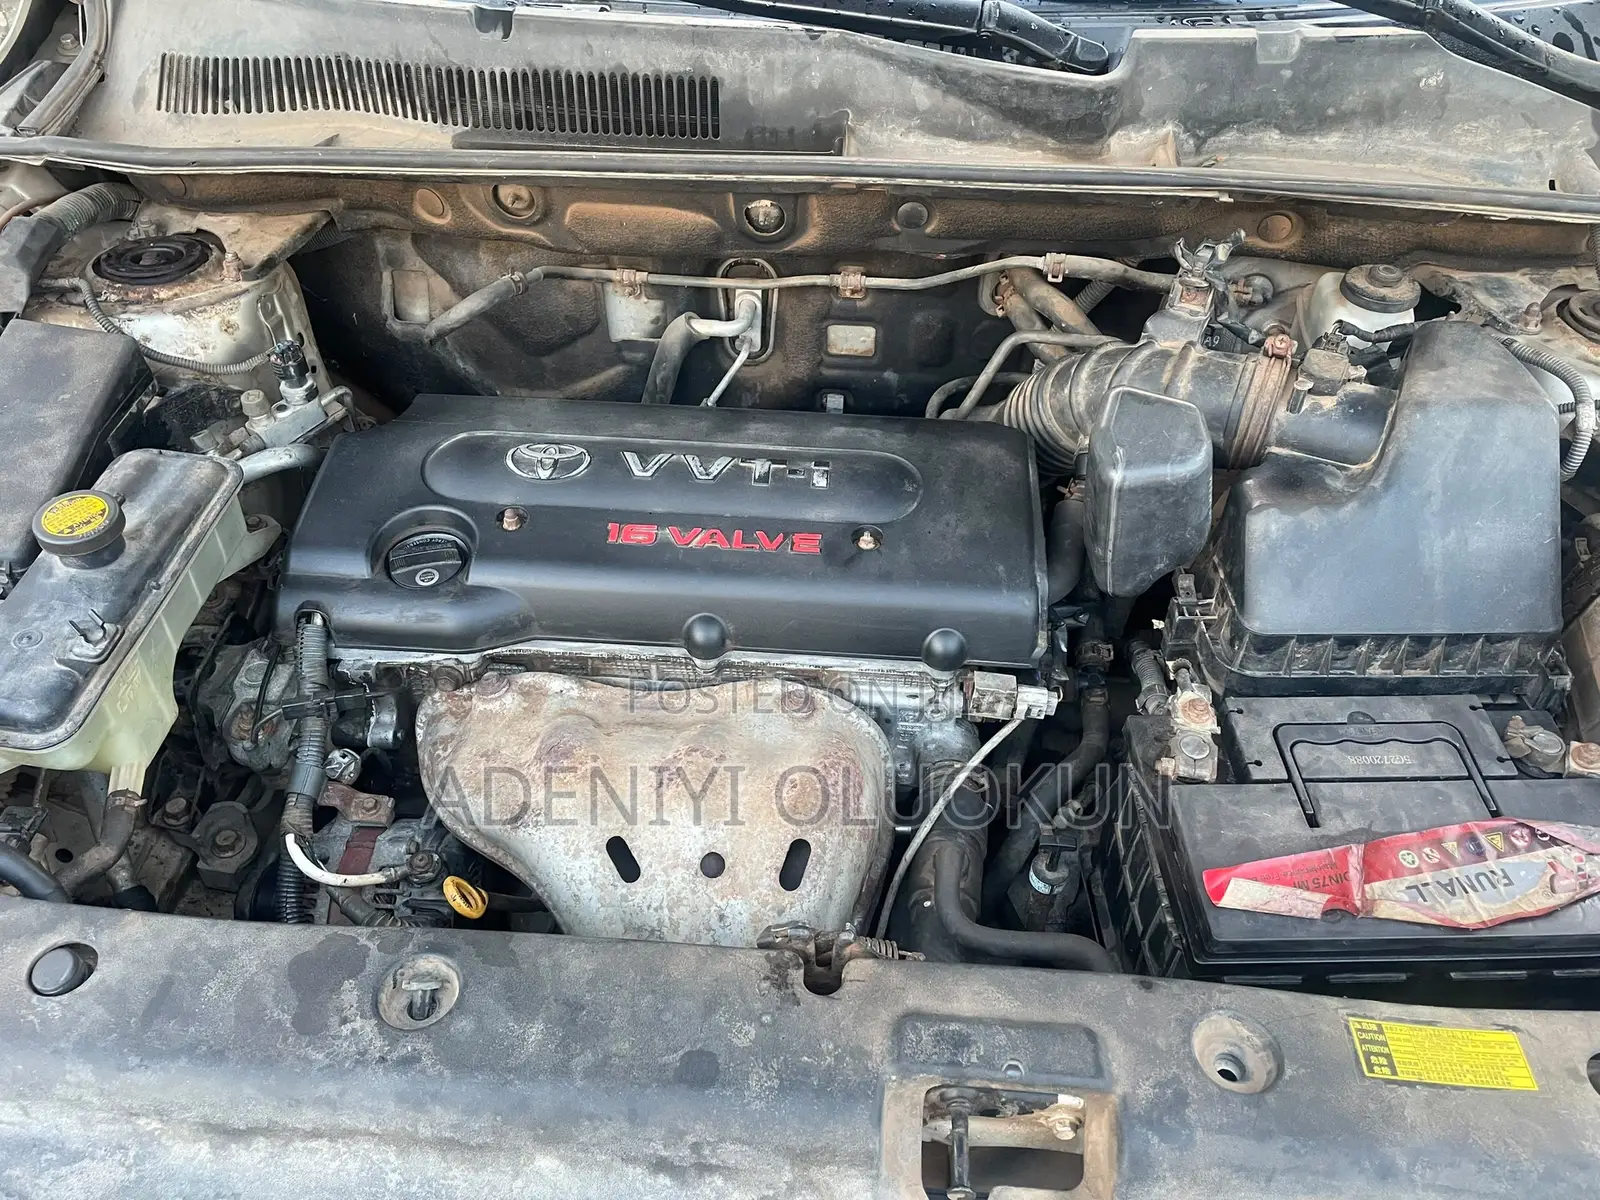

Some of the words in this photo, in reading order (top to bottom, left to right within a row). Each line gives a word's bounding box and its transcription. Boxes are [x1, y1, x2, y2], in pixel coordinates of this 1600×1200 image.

[606, 522, 658, 546] 16
[665, 525, 823, 555] VALVE
[1357, 1031, 1387, 1042] CAUTION
[1361, 1044, 1391, 1054] ATTENTION
